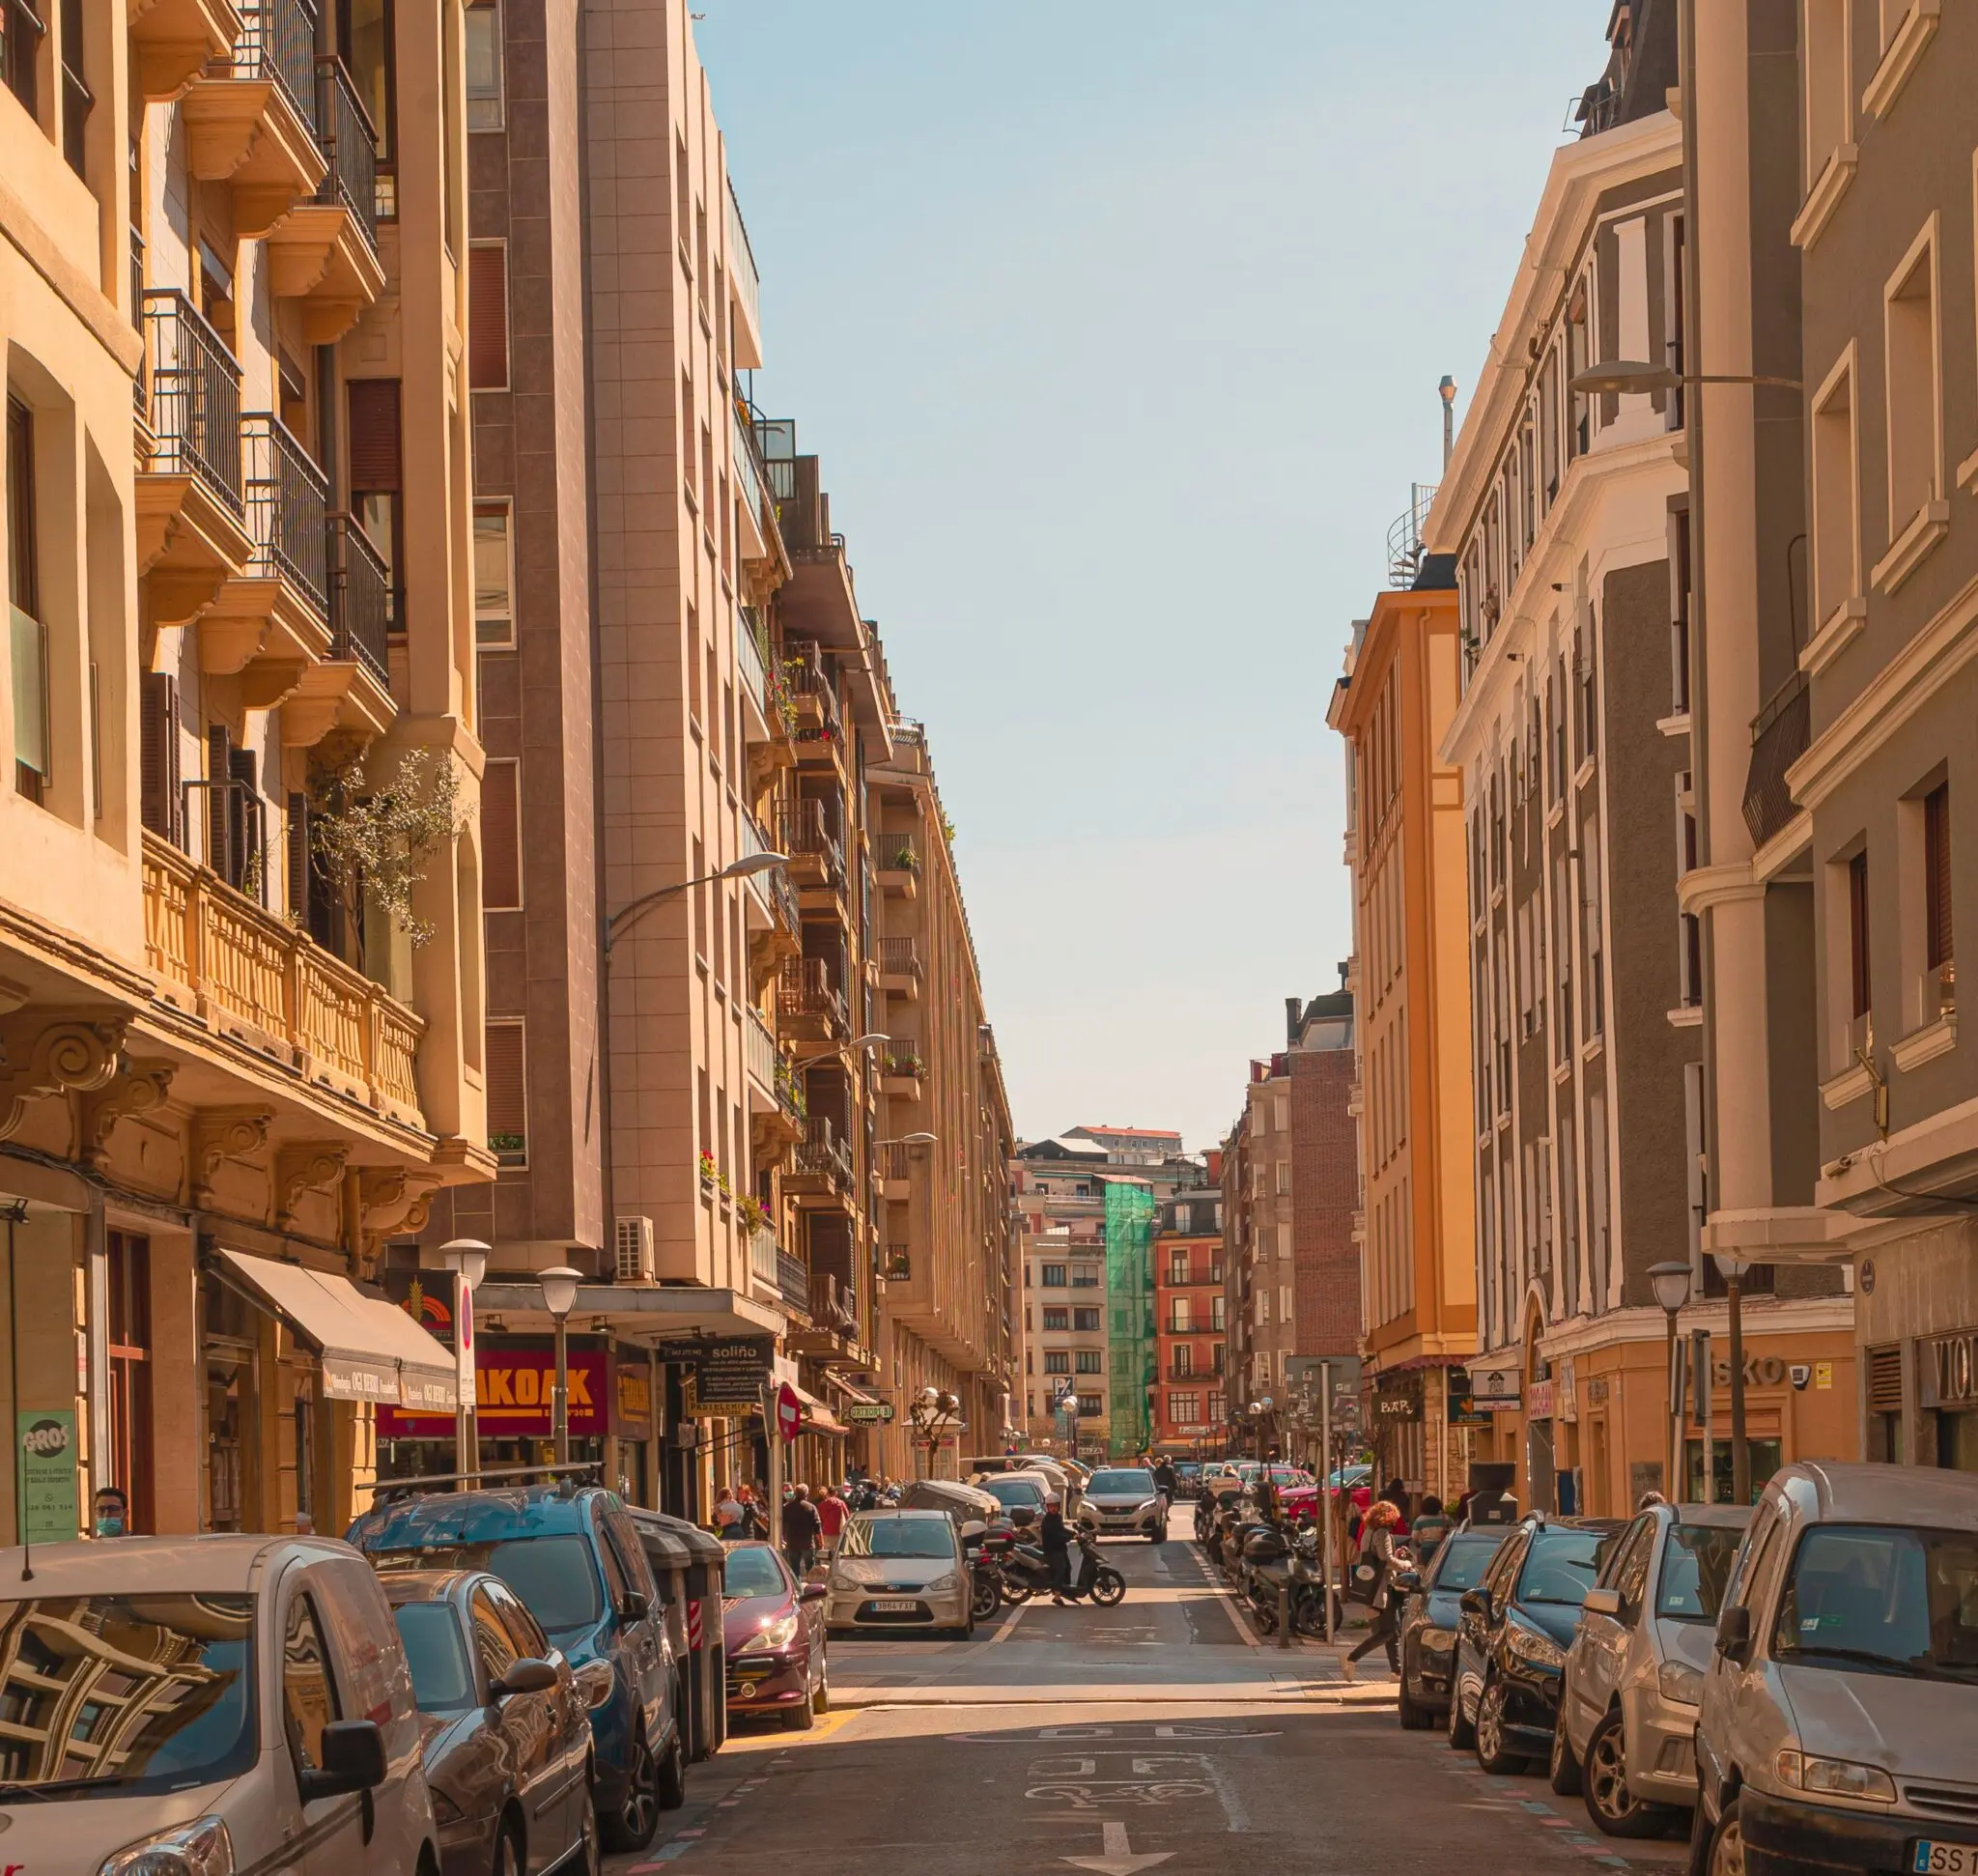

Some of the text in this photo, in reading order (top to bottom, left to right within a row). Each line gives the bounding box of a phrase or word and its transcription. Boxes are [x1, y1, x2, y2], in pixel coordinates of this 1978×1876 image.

[712, 1346, 757, 1358] soliño
[23, 1425, 71, 1452] GROS
[1932, 1846, 1964, 1873] SS
